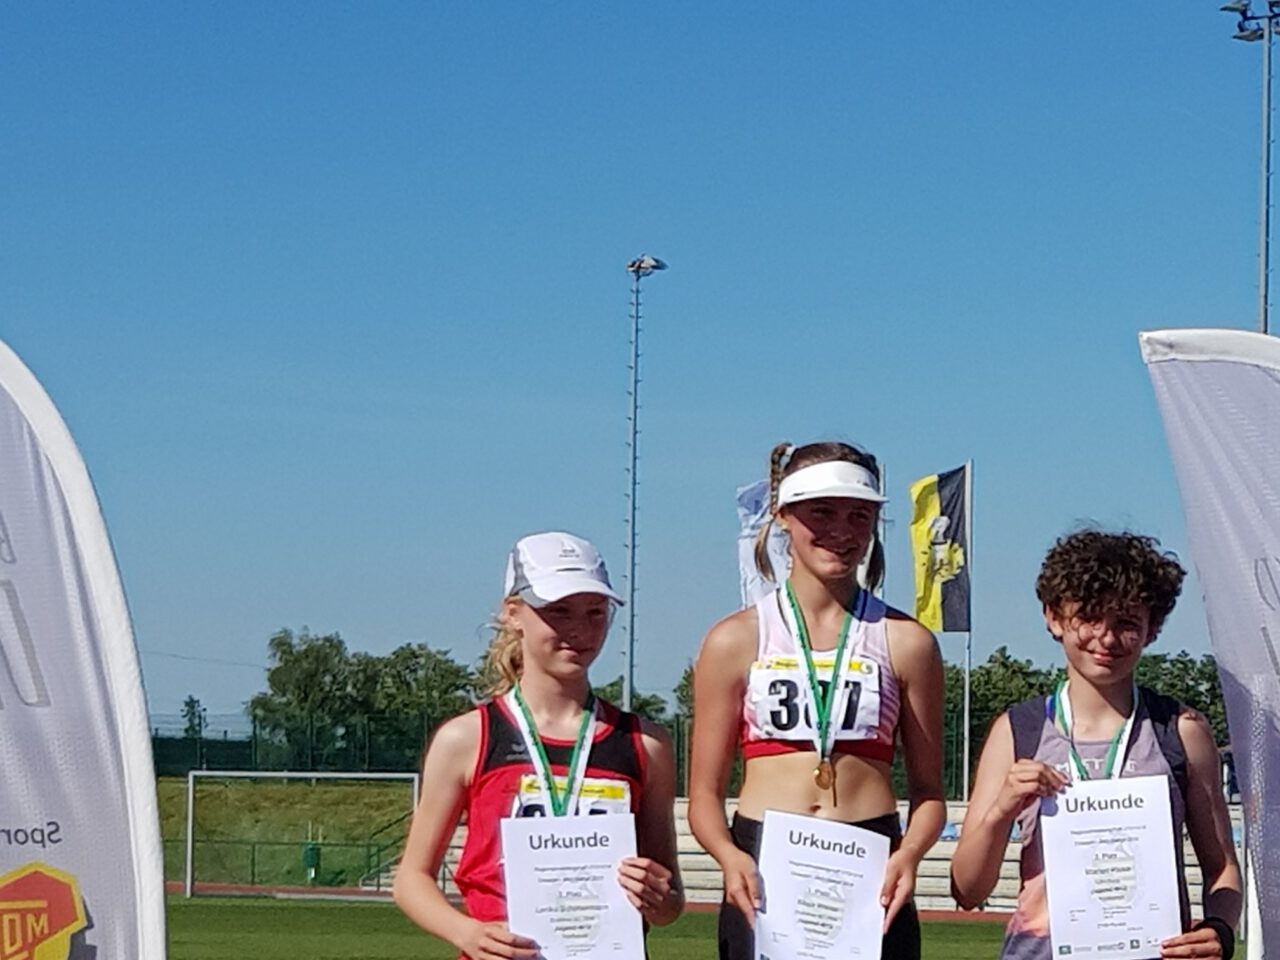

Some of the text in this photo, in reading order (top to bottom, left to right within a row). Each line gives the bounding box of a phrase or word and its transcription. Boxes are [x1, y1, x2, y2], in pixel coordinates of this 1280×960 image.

[1065, 794, 1144, 813] Urkunde
[529, 832, 610, 850] Urkunde
[789, 830, 867, 858] Urkunde
